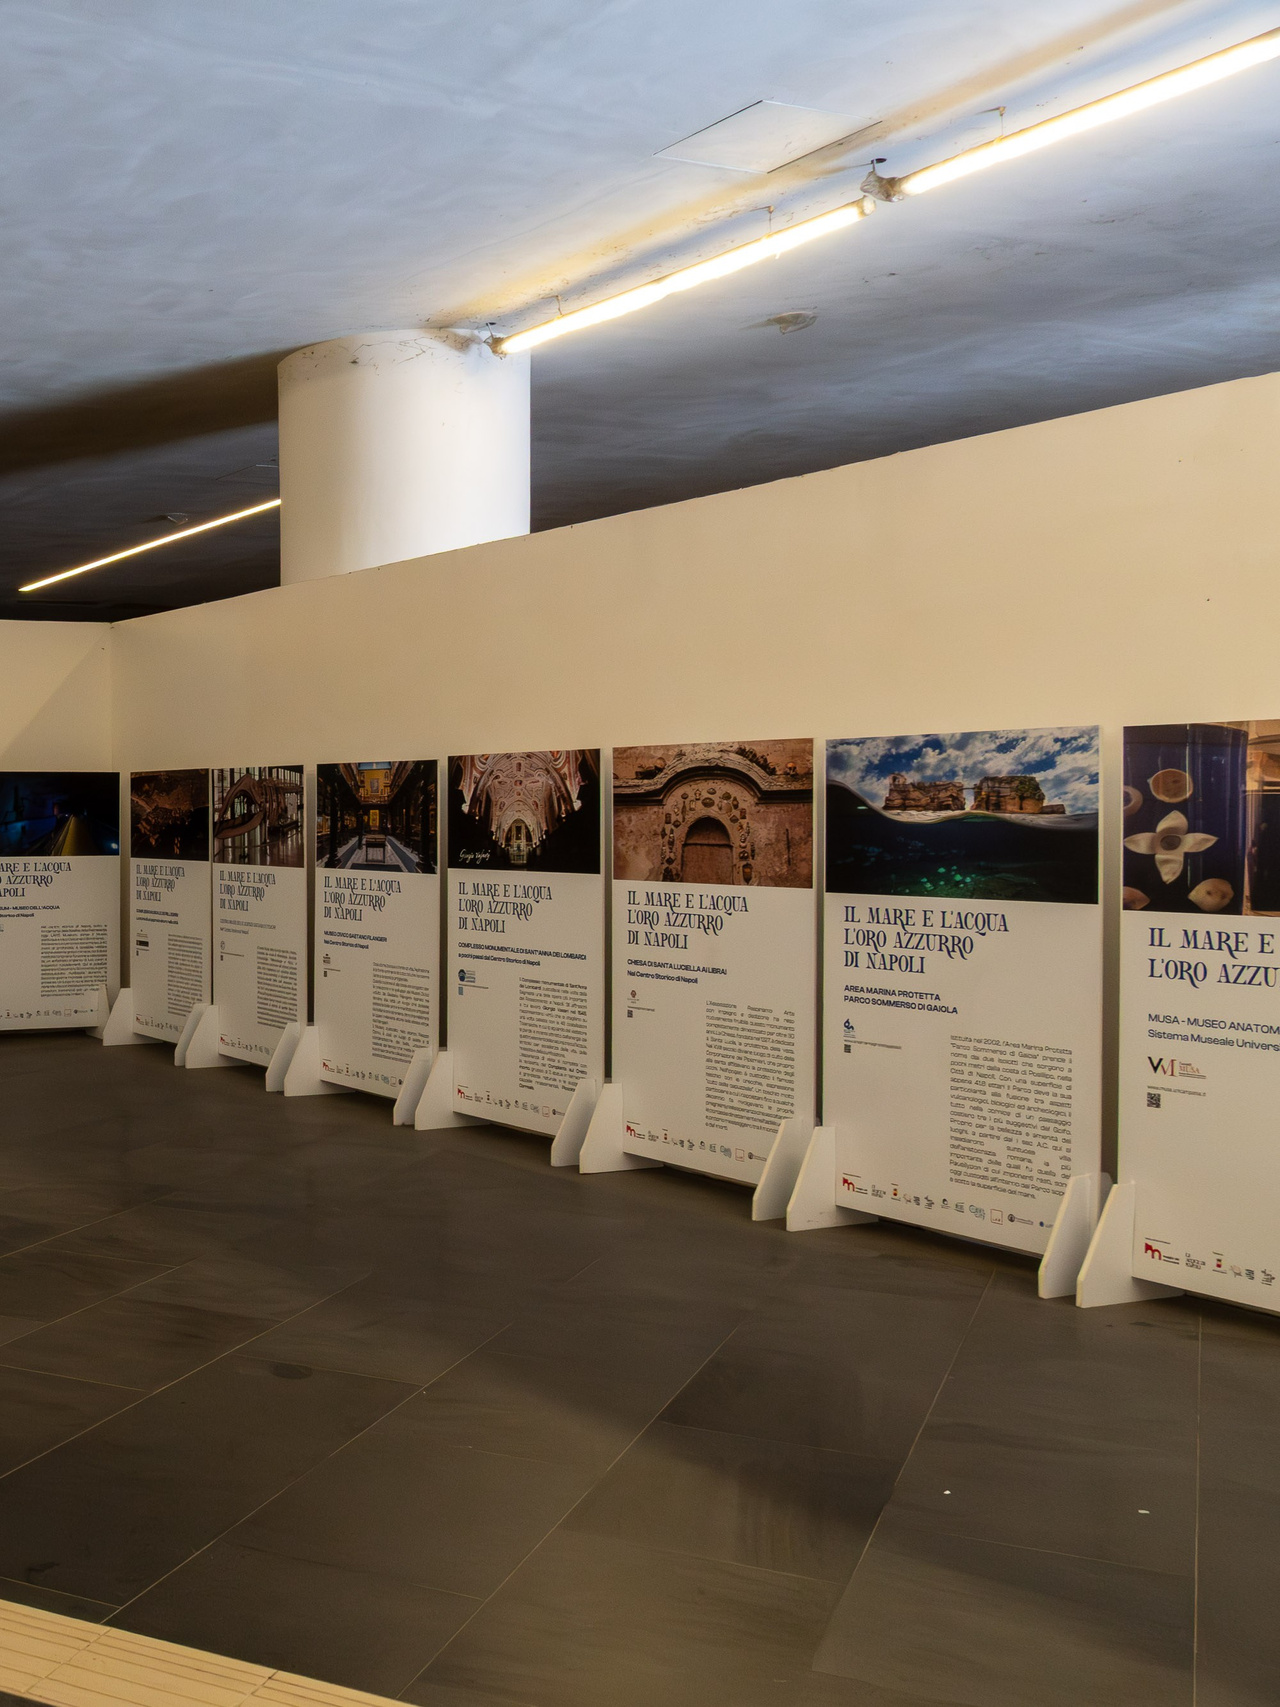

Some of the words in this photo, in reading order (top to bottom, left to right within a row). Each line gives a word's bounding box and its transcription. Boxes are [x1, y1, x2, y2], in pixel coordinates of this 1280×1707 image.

[23, 862, 30, 872] E
[34, 862, 72, 874] L'ACQUA
[6, 875, 53, 887] AZZURRO
[220, 870, 226, 881] IL
[227, 871, 245, 887] MARE
[247, 871, 251, 882] E
[253, 873, 276, 887] L'ACQUA
[324, 876, 332, 888] IL
[335, 877, 358, 895] MARE
[361, 879, 366, 891] E
[369, 879, 401, 896] L'ACQUA
[220, 883, 235, 898] L'ORO
[237, 885, 265, 902] AZZURRO
[324, 891, 345, 908] L'ORO
[348, 893, 386, 912] AZZURRO
[458, 882, 468, 895] IL
[472, 883, 500, 900] MARE
[503, 884, 510, 897] E
[514, 884, 552, 903] L'ACQUA
[220, 898, 227, 910] DI
[228, 899, 249, 912] NAPOLI
[458, 899, 483, 917] L'ORO
[487, 901, 533, 921] AZZURRO
[627, 891, 640, 906] IL
[644, 891, 680, 913] MARE
[685, 894, 694, 908] E
[699, 894, 748, 916] L'ACQUA
[324, 907, 331, 918] DI
[334, 907, 362, 921] NAPOLI
[627, 909, 659, 930] L'ORO
[664, 912, 723, 936] AZZURRO
[844, 905, 861, 923] IL
[866, 907, 915, 931] MARE
[922, 910, 934, 928] E
[941, 910, 1008, 936] L'ACQUA
[458, 917, 468, 930] DI
[471, 918, 505, 933] NAPOLI
[458, 942, 484, 950] COMPLESSO
[627, 930, 639, 945] DI
[644, 931, 688, 949] NAPOLI
[844, 928, 887, 954] L'ORO
[893, 932, 974, 960] AZZURRO
[1148, 927, 1171, 948] IL
[1179, 929, 1249, 960] MARE
[1258, 933, 1274, 954] E
[627, 958, 647, 967] CHIESA
[654, 961, 673, 969] SANTA
[673, 963, 700, 972] LUCIELLA
[708, 967, 727, 975] LIBRAI
[844, 951, 859, 968] DI
[866, 952, 925, 974] NAPOLI
[636, 971, 655, 979] Centro
[655, 972, 675, 981] Storico
[681, 976, 698, 984] Napoli
[1148, 958, 1207, 989] L'ORO
[1217, 963, 1280, 988] AZZU
[844, 985, 865, 993] AREA
[866, 987, 897, 997] MARINA
[898, 990, 941, 1001] PROTETTA
[844, 995, 870, 1005] PARCO
[871, 998, 916, 1010] SOMMERSO
[917, 1003, 926, 1011] DI
[927, 1004, 958, 1015] GAIOLA
[1148, 1013, 1180, 1025] MUSA
[1187, 1018, 1227, 1030] MUSEO
[1148, 1029, 1189, 1042] Sistema
[1190, 1033, 1235, 1046] Museale
